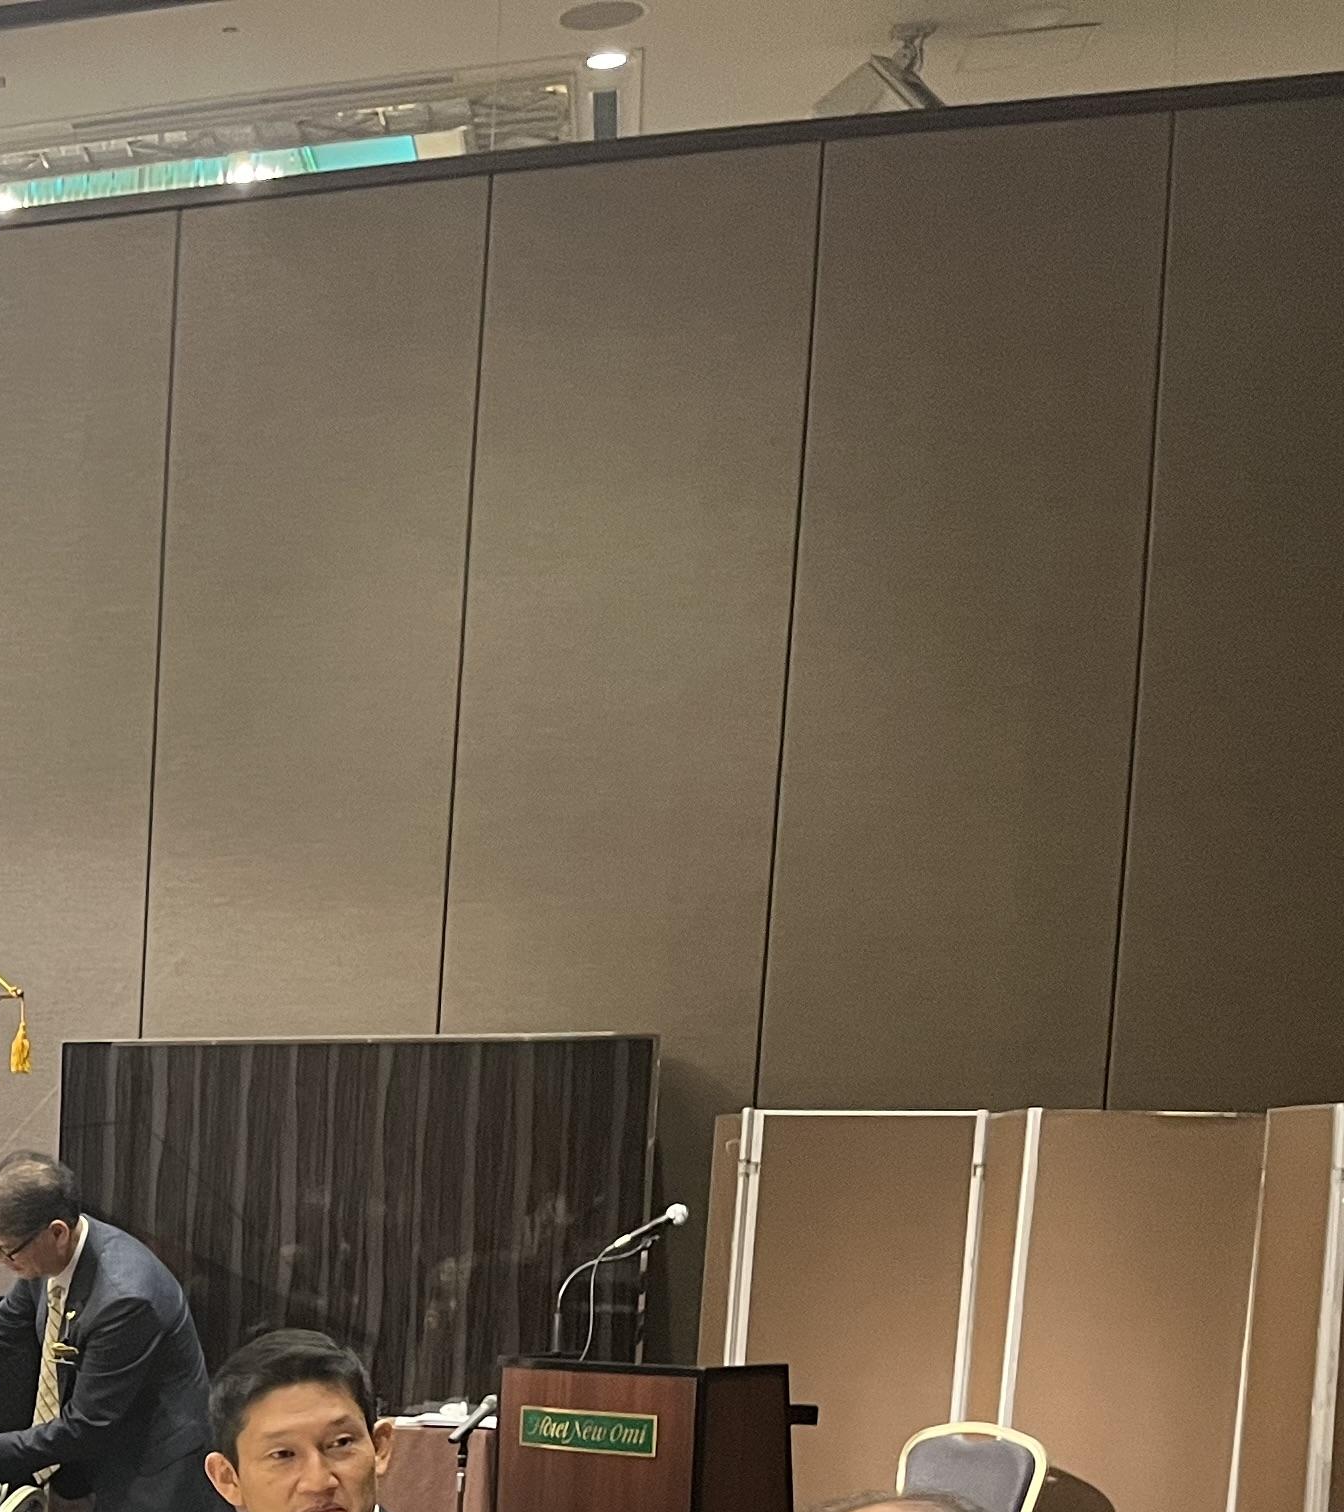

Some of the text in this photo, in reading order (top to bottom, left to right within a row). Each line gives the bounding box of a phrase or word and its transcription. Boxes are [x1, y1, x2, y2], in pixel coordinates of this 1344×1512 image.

[526, 1414, 648, 1445] Hotel New Omi
